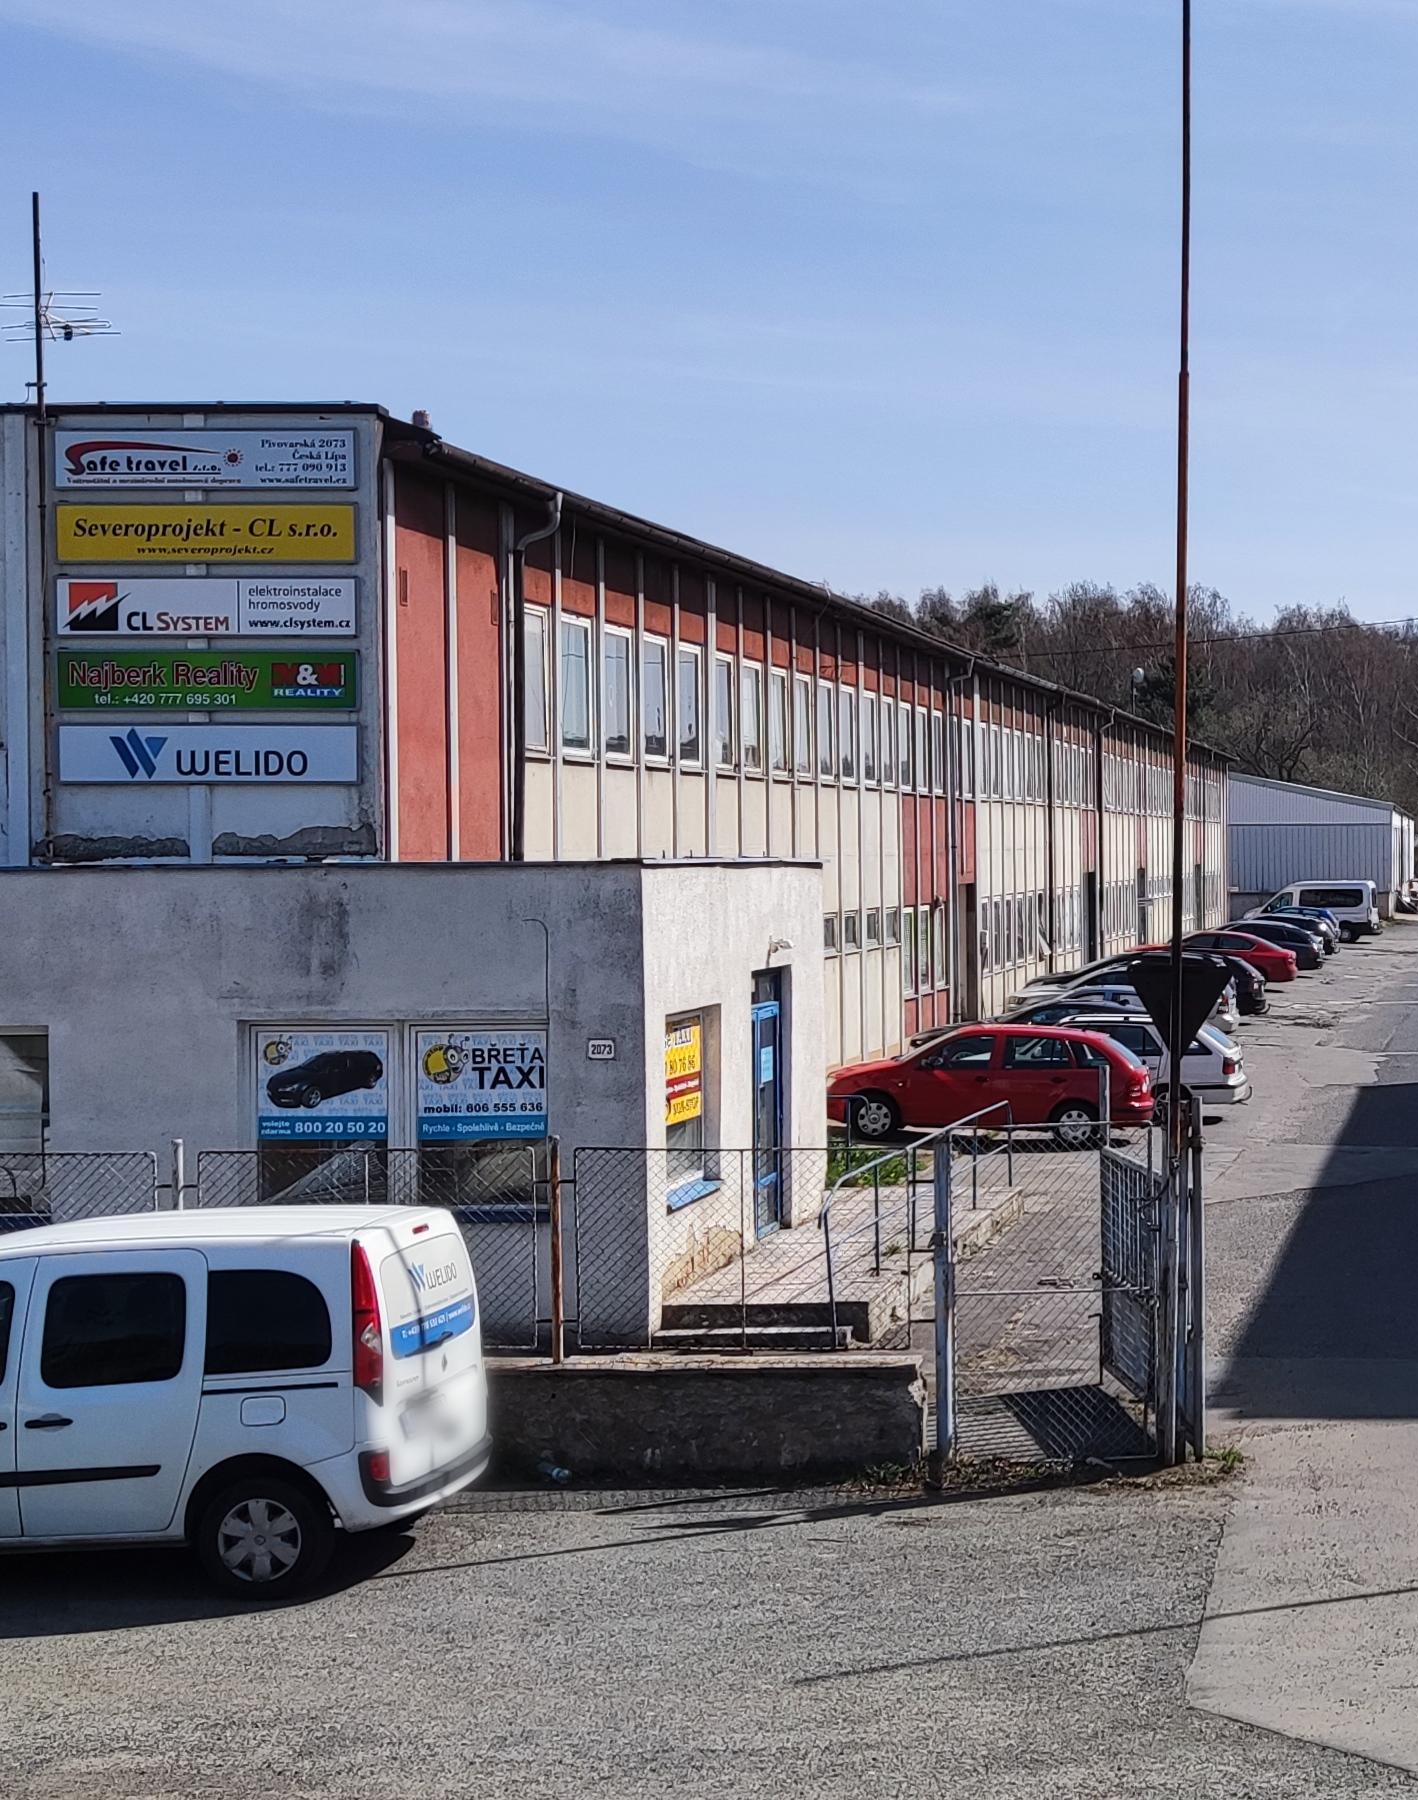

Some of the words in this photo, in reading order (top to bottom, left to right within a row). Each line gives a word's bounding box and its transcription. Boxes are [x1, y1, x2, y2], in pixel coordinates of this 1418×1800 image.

[261, 439, 315, 448] Pivovarská
[318, 439, 346, 448] 2073
[292, 449, 322, 460] Česká
[325, 450, 347, 462] Lípa
[126, 455, 187, 472] travel
[255, 463, 275, 472] tel.:
[278, 463, 299, 472] 777
[302, 463, 323, 472] 090
[326, 463, 347, 472] 913
[260, 475, 347, 485] www.safetravel.cz
[73, 518, 227, 541] Severoprojekt
[248, 518, 283, 537] CL
[288, 521, 339, 537] s.r.o.
[136, 545, 275, 556] www.severoprojekt.cz
[248, 585, 342, 597] elektroinstalace
[248, 599, 321, 612] hromosvody
[248, 616, 351, 630] www.clsystem.cz
[68, 661, 167, 692] Najberk
[173, 661, 260, 692] Reality
[94, 693, 120, 705] tel.:
[123, 694, 155, 705] +420
[159, 694, 182, 705] 777
[186, 694, 210, 705] 695
[213, 694, 237, 705] 301
[273, 688, 343, 697] REALITY
[176, 750, 308, 777] WELIDO
[472, 1042, 545, 1065] BŘEŤA
[591, 1044, 613, 1055] 2073
[472, 1066, 545, 1090] TAXI
[423, 1104, 463, 1114] mobil:
[493, 1102, 516, 1113] 555
[520, 1102, 543, 1112] 636
[294, 1121, 323, 1134] 800
[325, 1121, 344, 1134] 20
[347, 1121, 365, 1134] 50
[368, 1121, 387, 1134] 20
[422, 1123, 451, 1135] Rychle
[457, 1123, 500, 1134] Spolehlivě
[505, 1122, 546, 1134] Bezpečně
[426, 1262, 457, 1290] WELIDO
